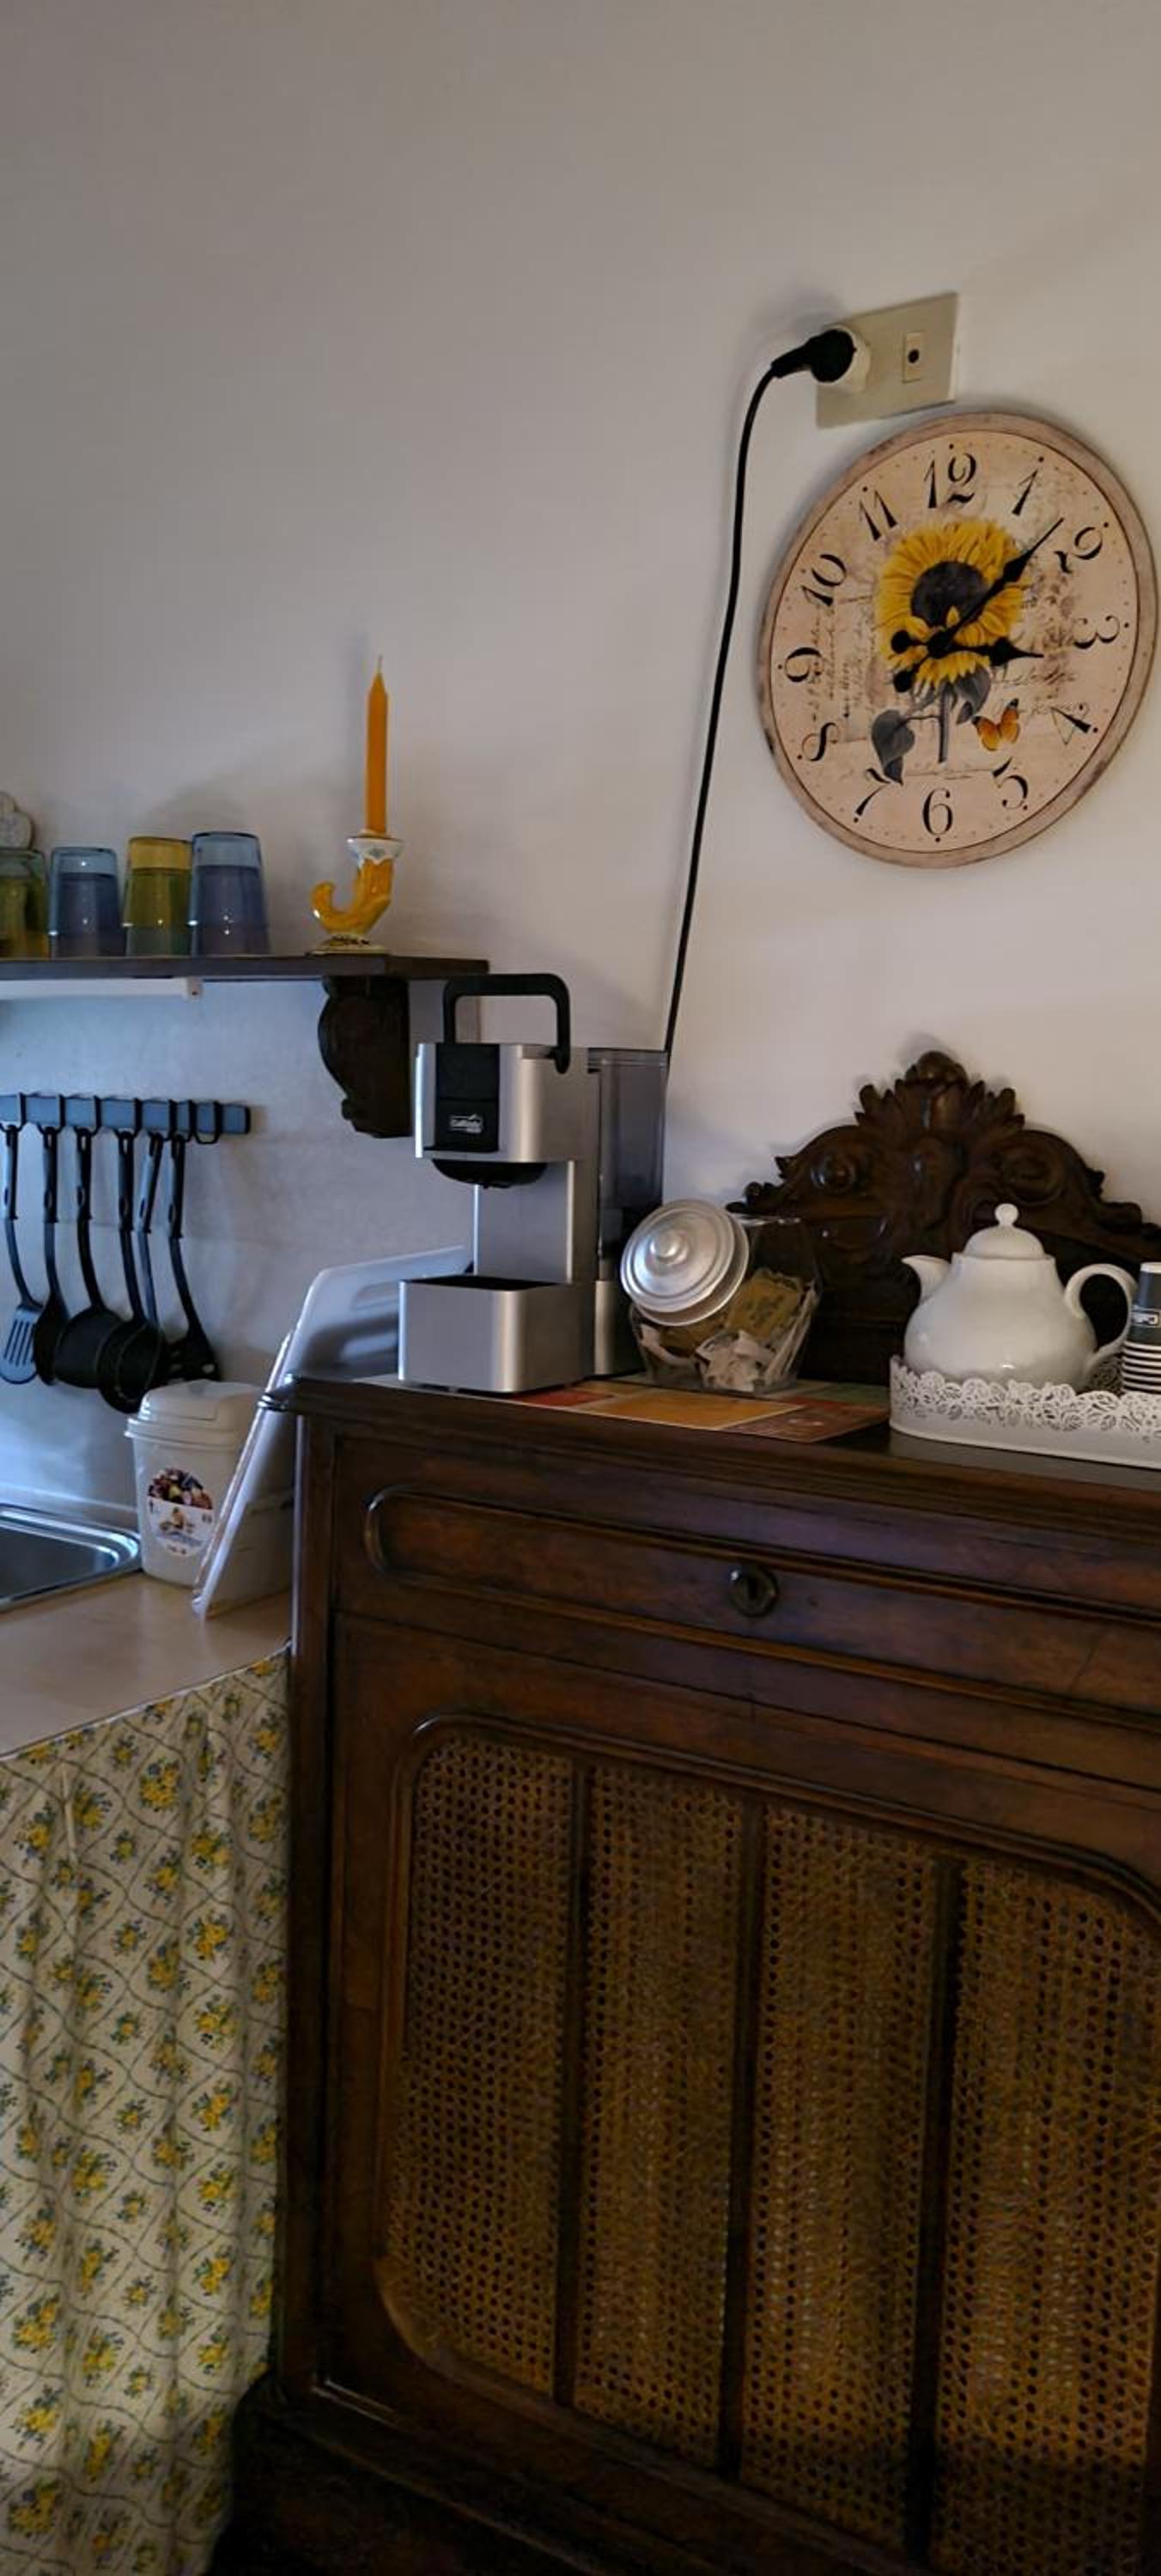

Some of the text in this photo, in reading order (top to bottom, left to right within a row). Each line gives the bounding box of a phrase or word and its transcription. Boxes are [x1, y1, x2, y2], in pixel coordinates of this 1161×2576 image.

[923, 452, 977, 508] 12
[1012, 468, 1040, 516] 1
[859, 489, 898, 542] 11
[1055, 526, 1104, 574] 2
[799, 553, 848, 608] 10
[1073, 614, 1121, 650] 3
[783, 647, 822, 683] 9
[801, 721, 840, 762] 8
[1050, 703, 1092, 746] 4
[855, 766, 892, 817] 7
[992, 756, 1030, 810] 5
[921, 788, 953, 835] 6
